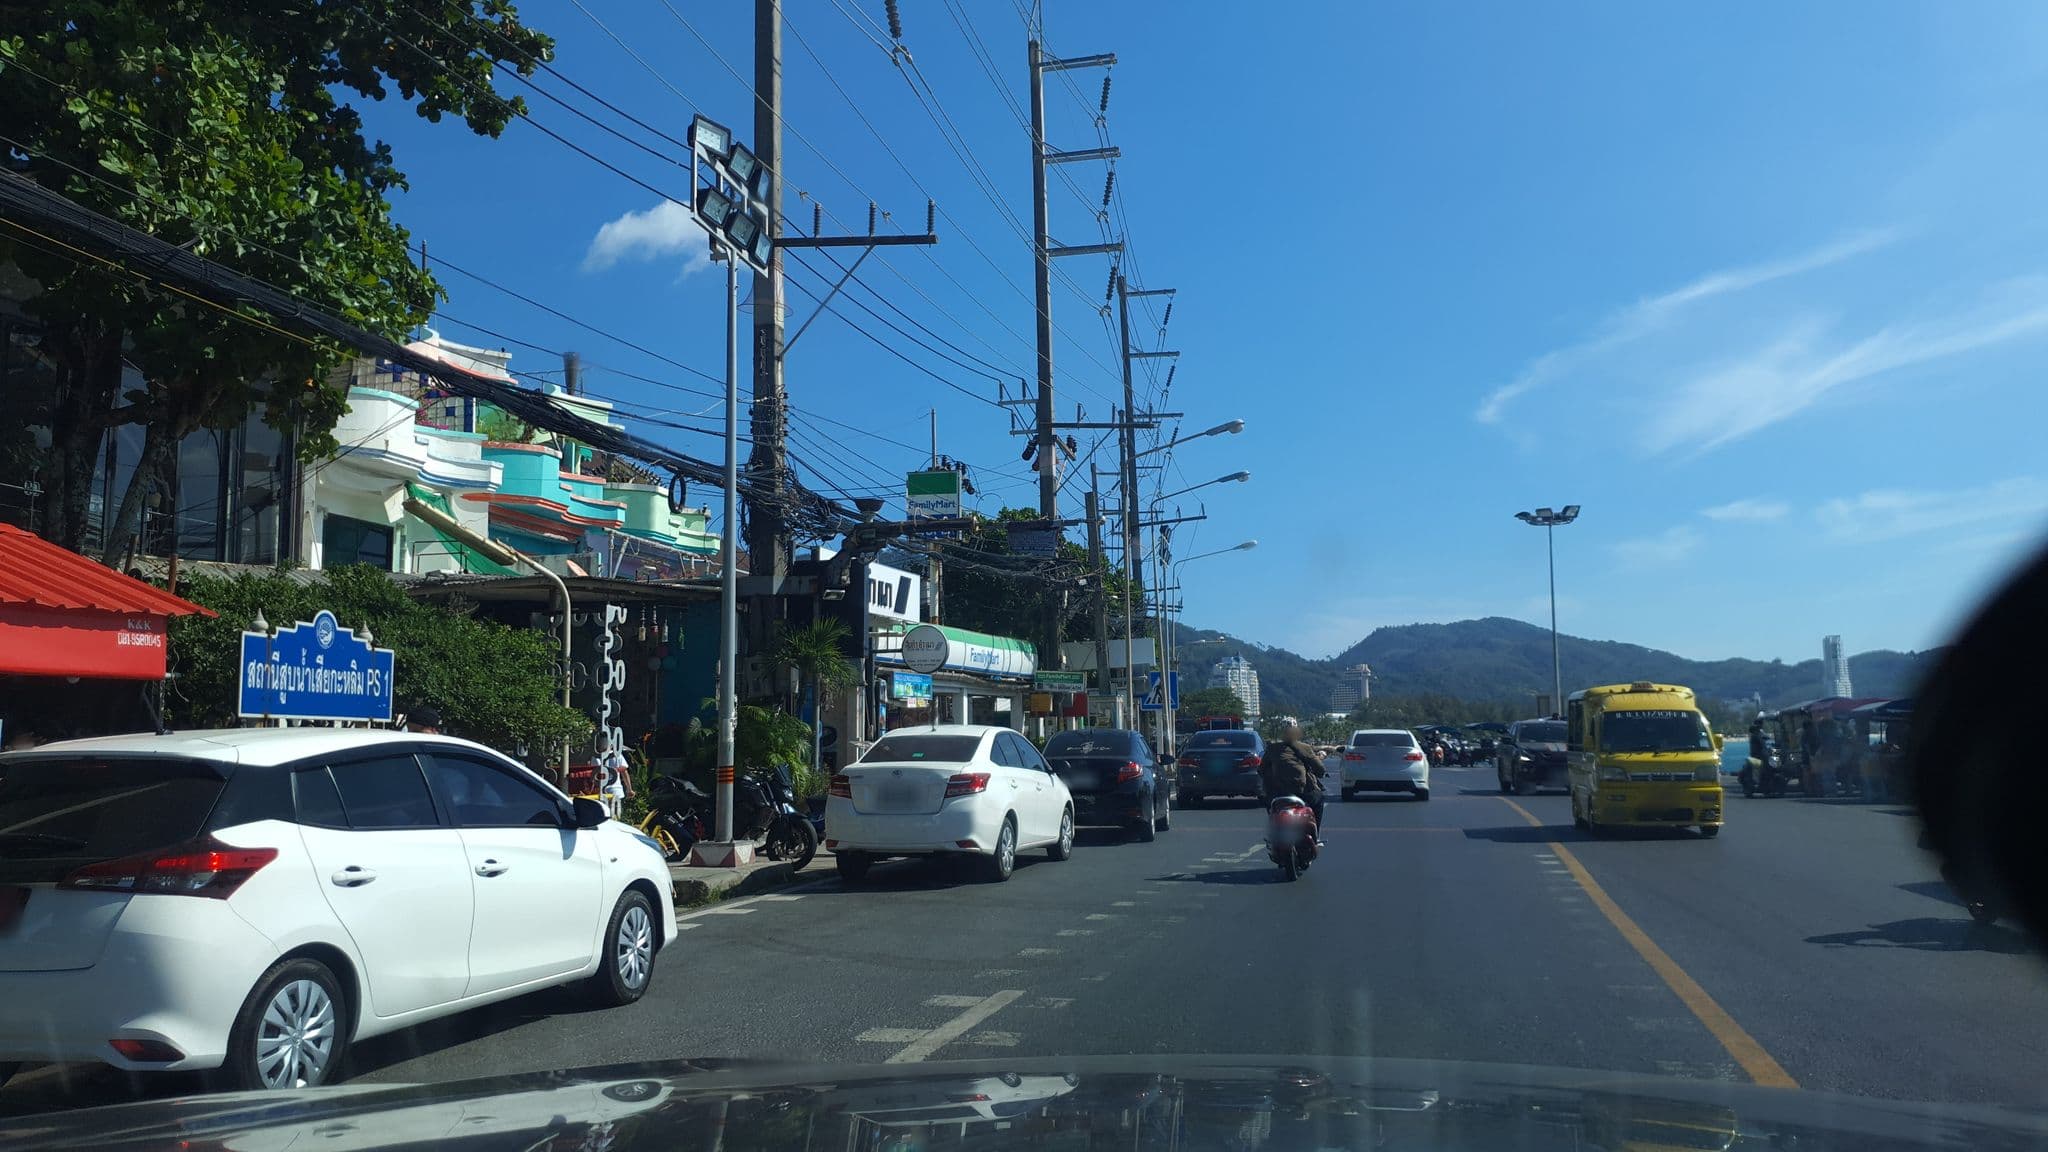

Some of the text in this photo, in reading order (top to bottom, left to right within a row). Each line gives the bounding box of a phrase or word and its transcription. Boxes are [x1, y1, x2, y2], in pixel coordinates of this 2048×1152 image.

[908, 500, 956, 510] FamilyMart
[367, 668, 381, 697] PS
[384, 670, 389, 697] 1
